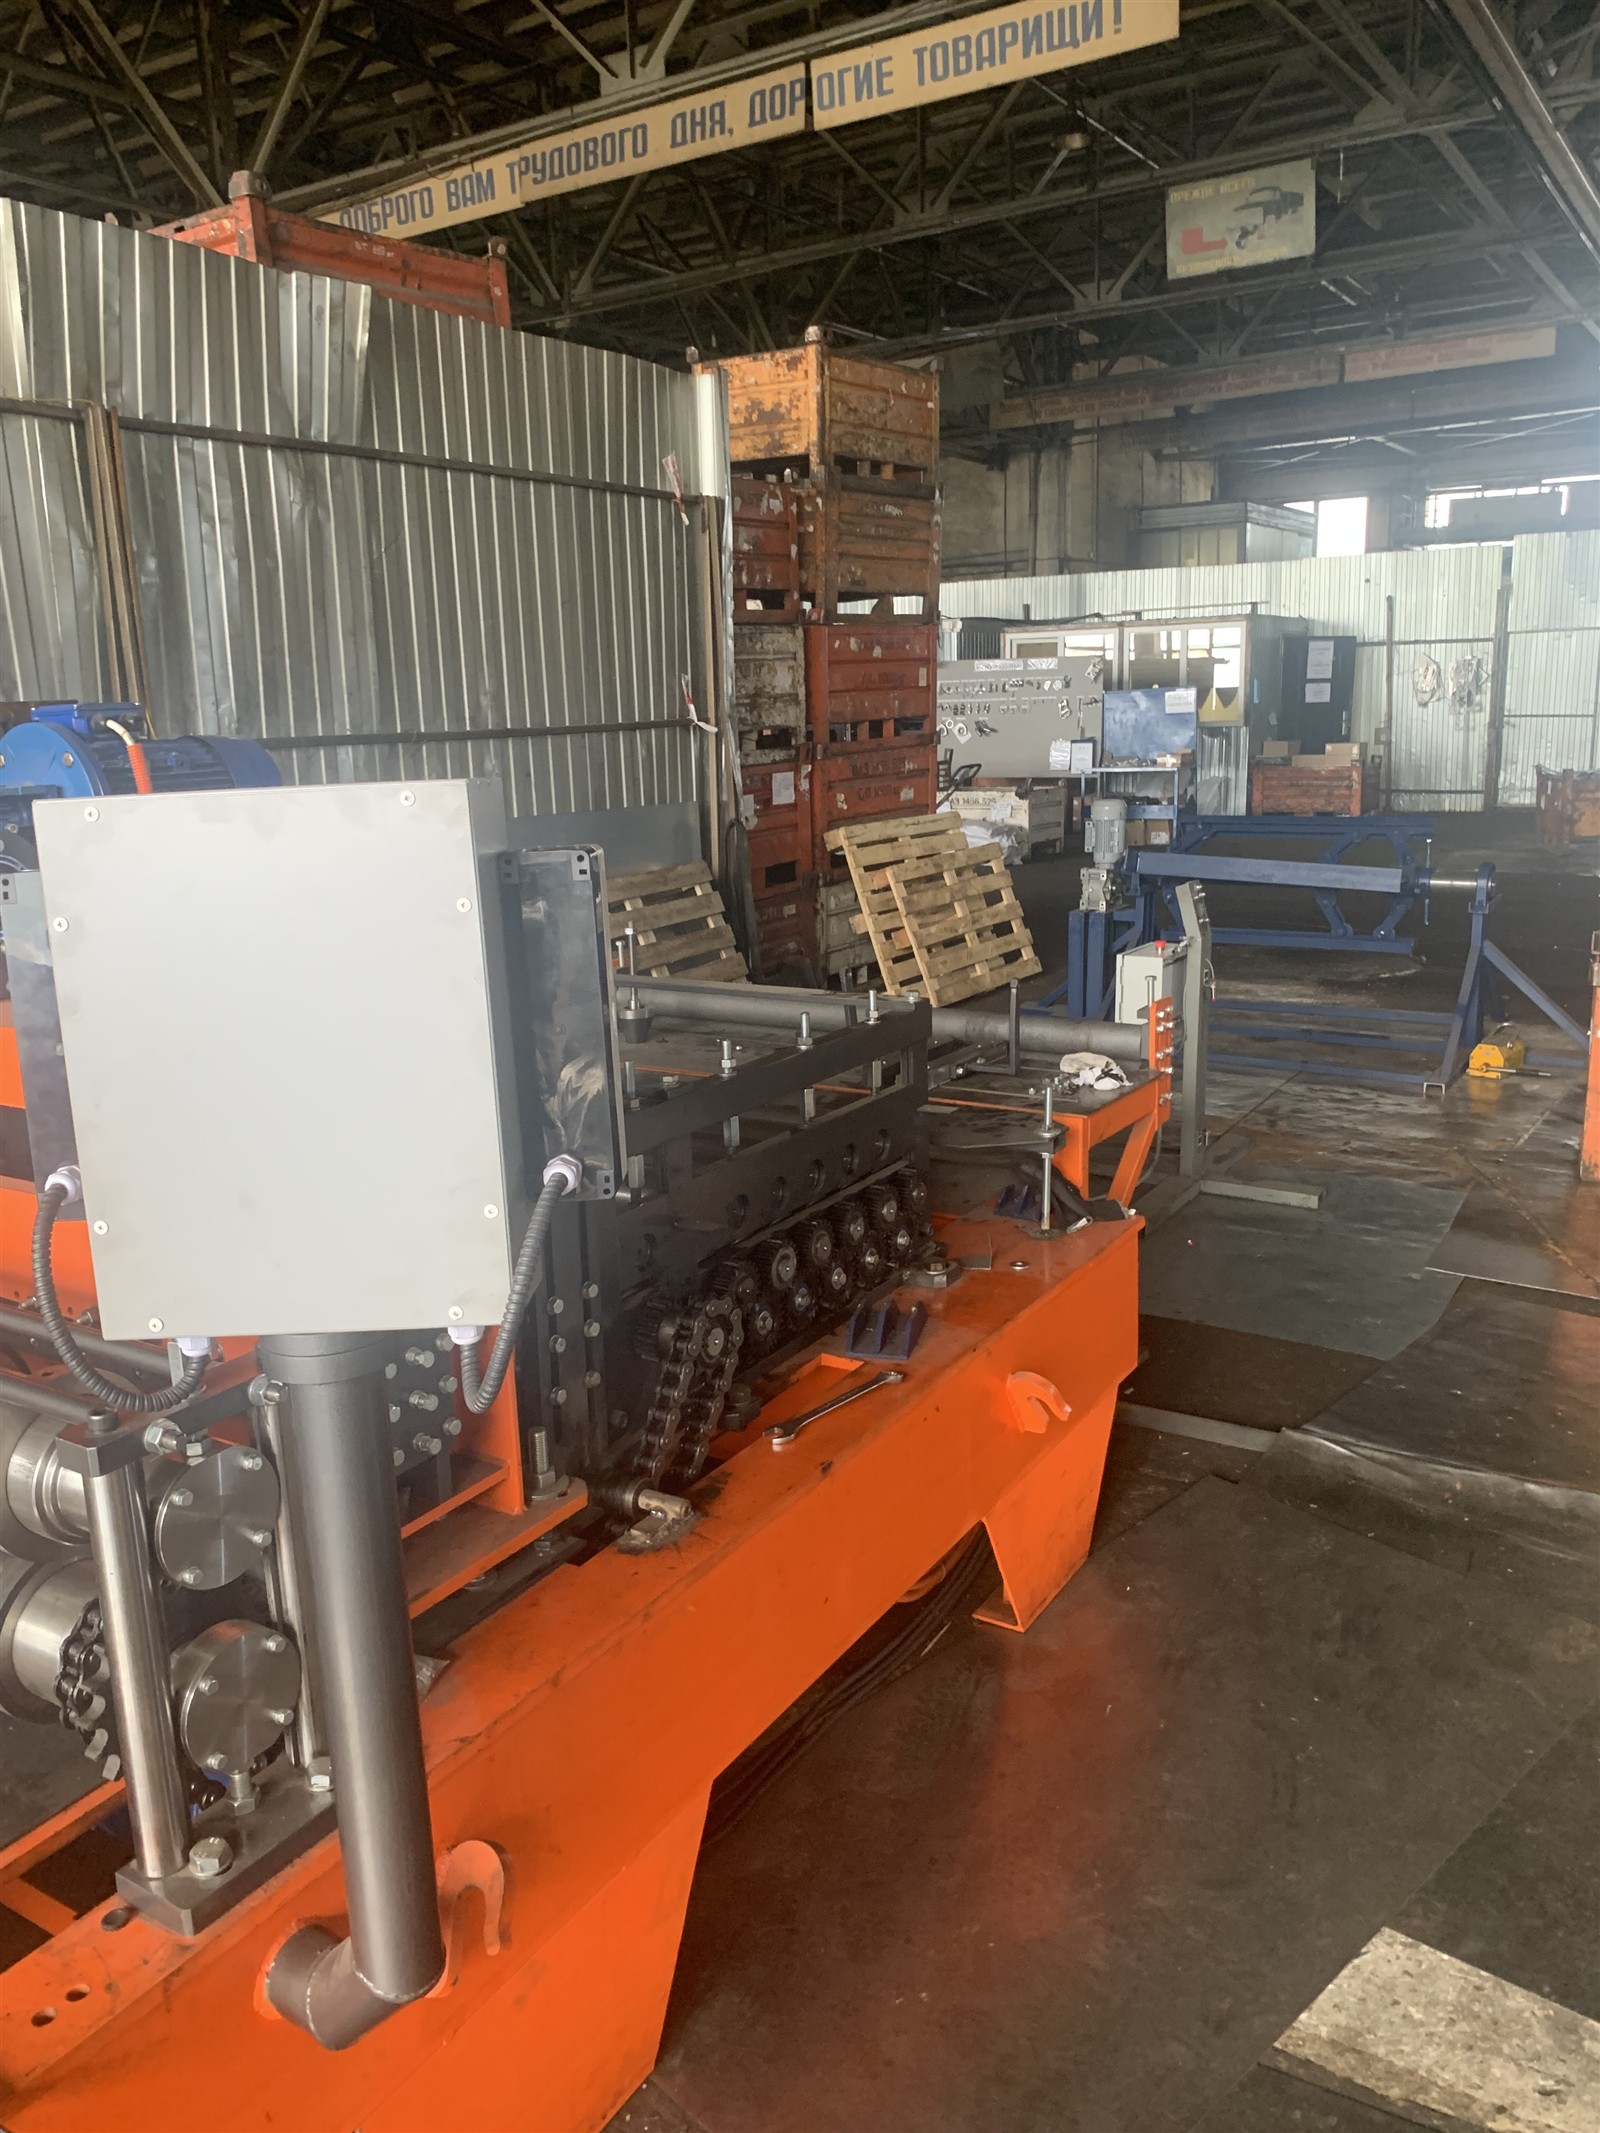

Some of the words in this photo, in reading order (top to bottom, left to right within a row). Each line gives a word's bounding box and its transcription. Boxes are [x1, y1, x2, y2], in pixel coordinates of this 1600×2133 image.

[339, 186, 435, 235] ДОБРОГО
[446, 168, 496, 212] ВАМ
[506, 123, 649, 194] ТРУДОВОГО
[669, 100, 735, 149] ДНЯ,
